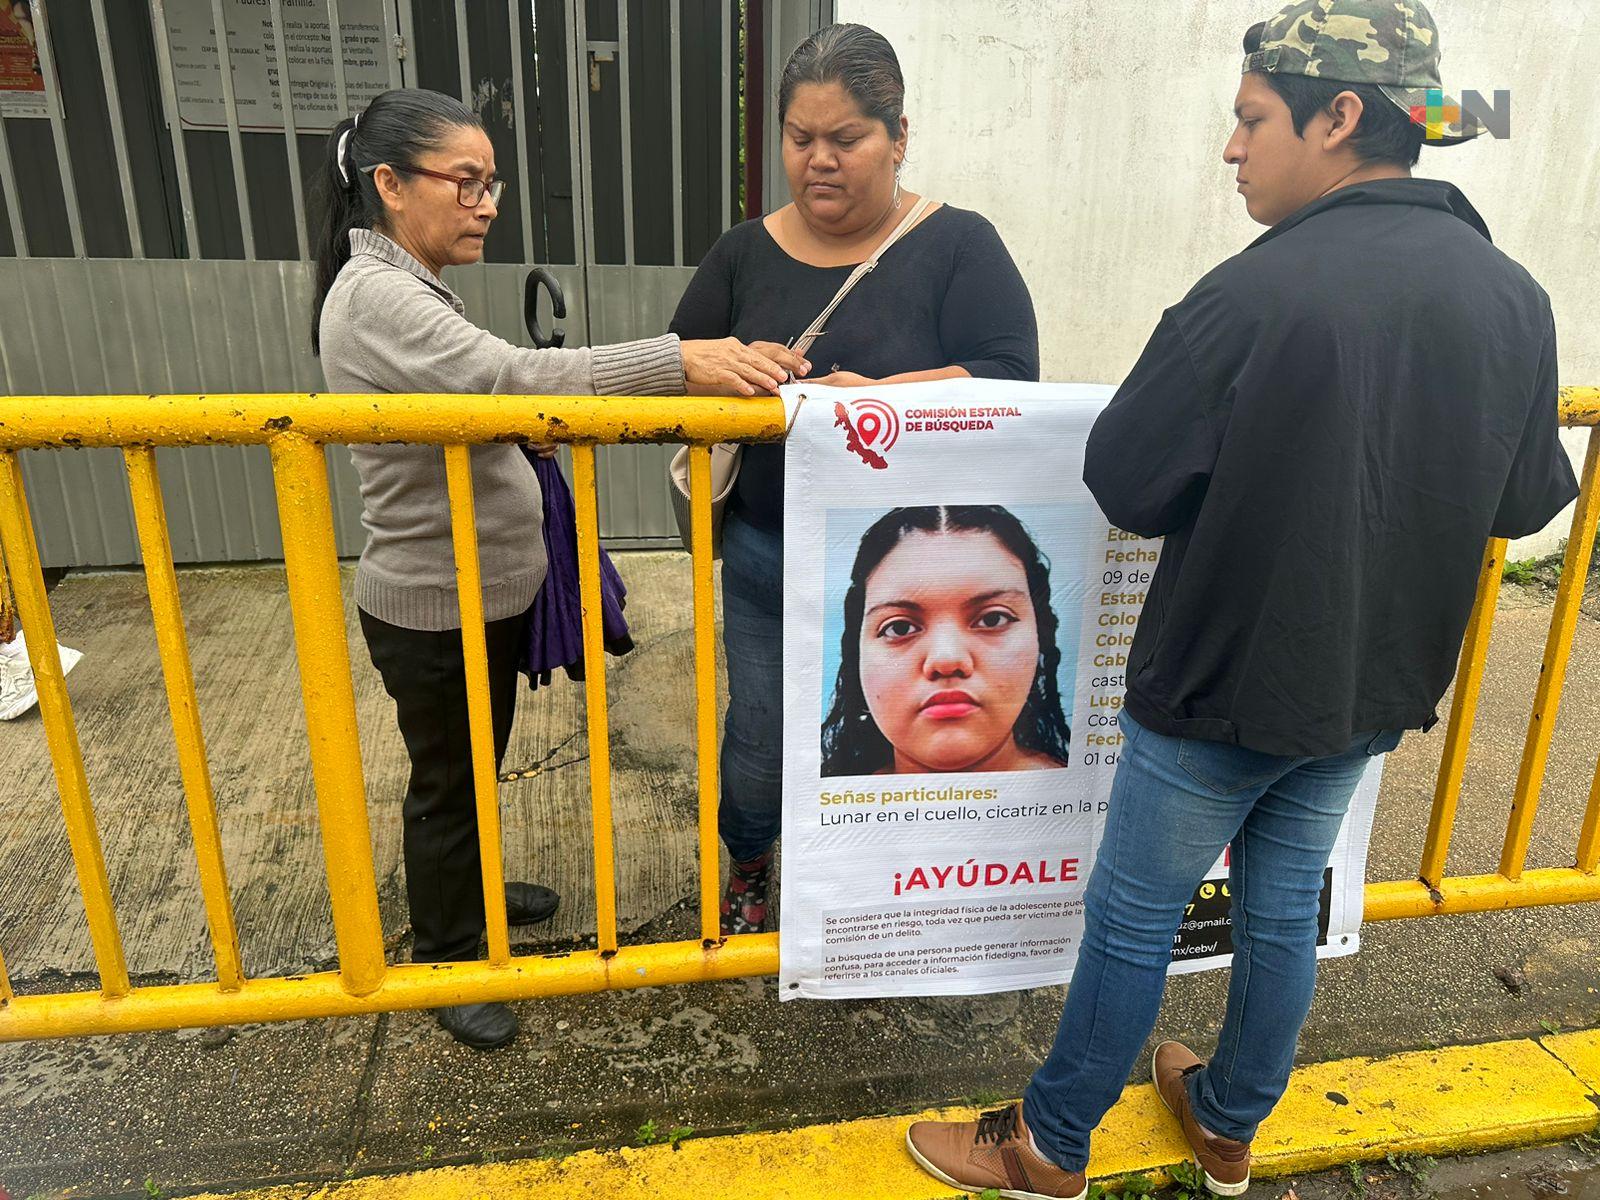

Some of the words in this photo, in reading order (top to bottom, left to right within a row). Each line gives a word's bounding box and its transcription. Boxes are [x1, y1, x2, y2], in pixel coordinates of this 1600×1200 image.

[905, 406, 967, 419] COMISIÓN
[969, 407, 1022, 417] ESTATAL
[905, 421, 922, 432] DE
[924, 418, 994, 433] BÚSQUEDA
[1105, 548, 1158, 564] Fecha
[1102, 570, 1123, 585] 09
[1128, 569, 1150, 584] de
[1100, 591, 1145, 606] Estat
[1095, 632, 1134, 647] Colo
[1093, 652, 1126, 667] Cab
[1091, 675, 1125, 688] cast
[1087, 714, 1118, 727] Coa
[1086, 732, 1125, 747] Fech
[1084, 752, 1099, 765] 01
[820, 790, 876, 805] Señas
[881, 786, 998, 805] particulares:
[821, 812, 872, 826] Lunar
[876, 811, 899, 822] en
[904, 808, 919, 821] el
[924, 806, 981, 821] cuello,
[985, 803, 1048, 819] cicatriz
[1052, 803, 1073, 815] en
[1078, 799, 1092, 813] la
[1097, 801, 1109, 814] p
[893, 858, 1079, 896] ¡AYÚDALE
[825, 917, 838, 925] Se
[839, 914, 882, 924] considera
[883, 911, 902, 920] que
[903, 909, 912, 917] la
[913, 907, 959, 918] integridad
[961, 905, 984, 914] física
[986, 904, 998, 912] de
[999, 903, 1008, 911] la
[1009, 900, 1062, 911] adolescente
[1182, 903, 1195, 916] 7
[825, 923, 879, 935] encontrarse
[894, 920, 924, 929] riesgo,
[925, 917, 946, 926] toda
[964, 916, 982, 925] que
[983, 913, 1011, 923] pueda
[1028, 910, 1060, 919] víctima
[1062, 909, 1074, 917] de
[1178, 917, 1232, 930] z@gmail.c
[825, 934, 867, 945] comisión
[867, 932, 880, 941] de
[881, 931, 894, 939] un
[895, 928, 923, 938] delito.
[1172, 934, 1182, 944] 11
[825, 956, 836, 964] La
[837, 951, 883, 963] búsqueda
[884, 950, 896, 958] de
[897, 949, 915, 957] una
[916, 946, 952, 957] persona
[954, 943, 983, 953] puede
[983, 941, 1018, 951] generar
[1019, 936, 1071, 947] información
[1170, 941, 1218, 956] mx/cebv/
[824, 961, 862, 972] confusa,
[863, 961, 884, 970] para
[885, 957, 921, 967] acceder
[930, 953, 984, 964] información
[984, 950, 1029, 961] fidedigna,
[1030, 948, 1052, 956] favor
[1052, 946, 1064, 954] de
[824, 971, 861, 981] referirse
[870, 970, 884, 978] los
[885, 967, 919, 977] canales
[920, 965, 960, 975] oficiales.
